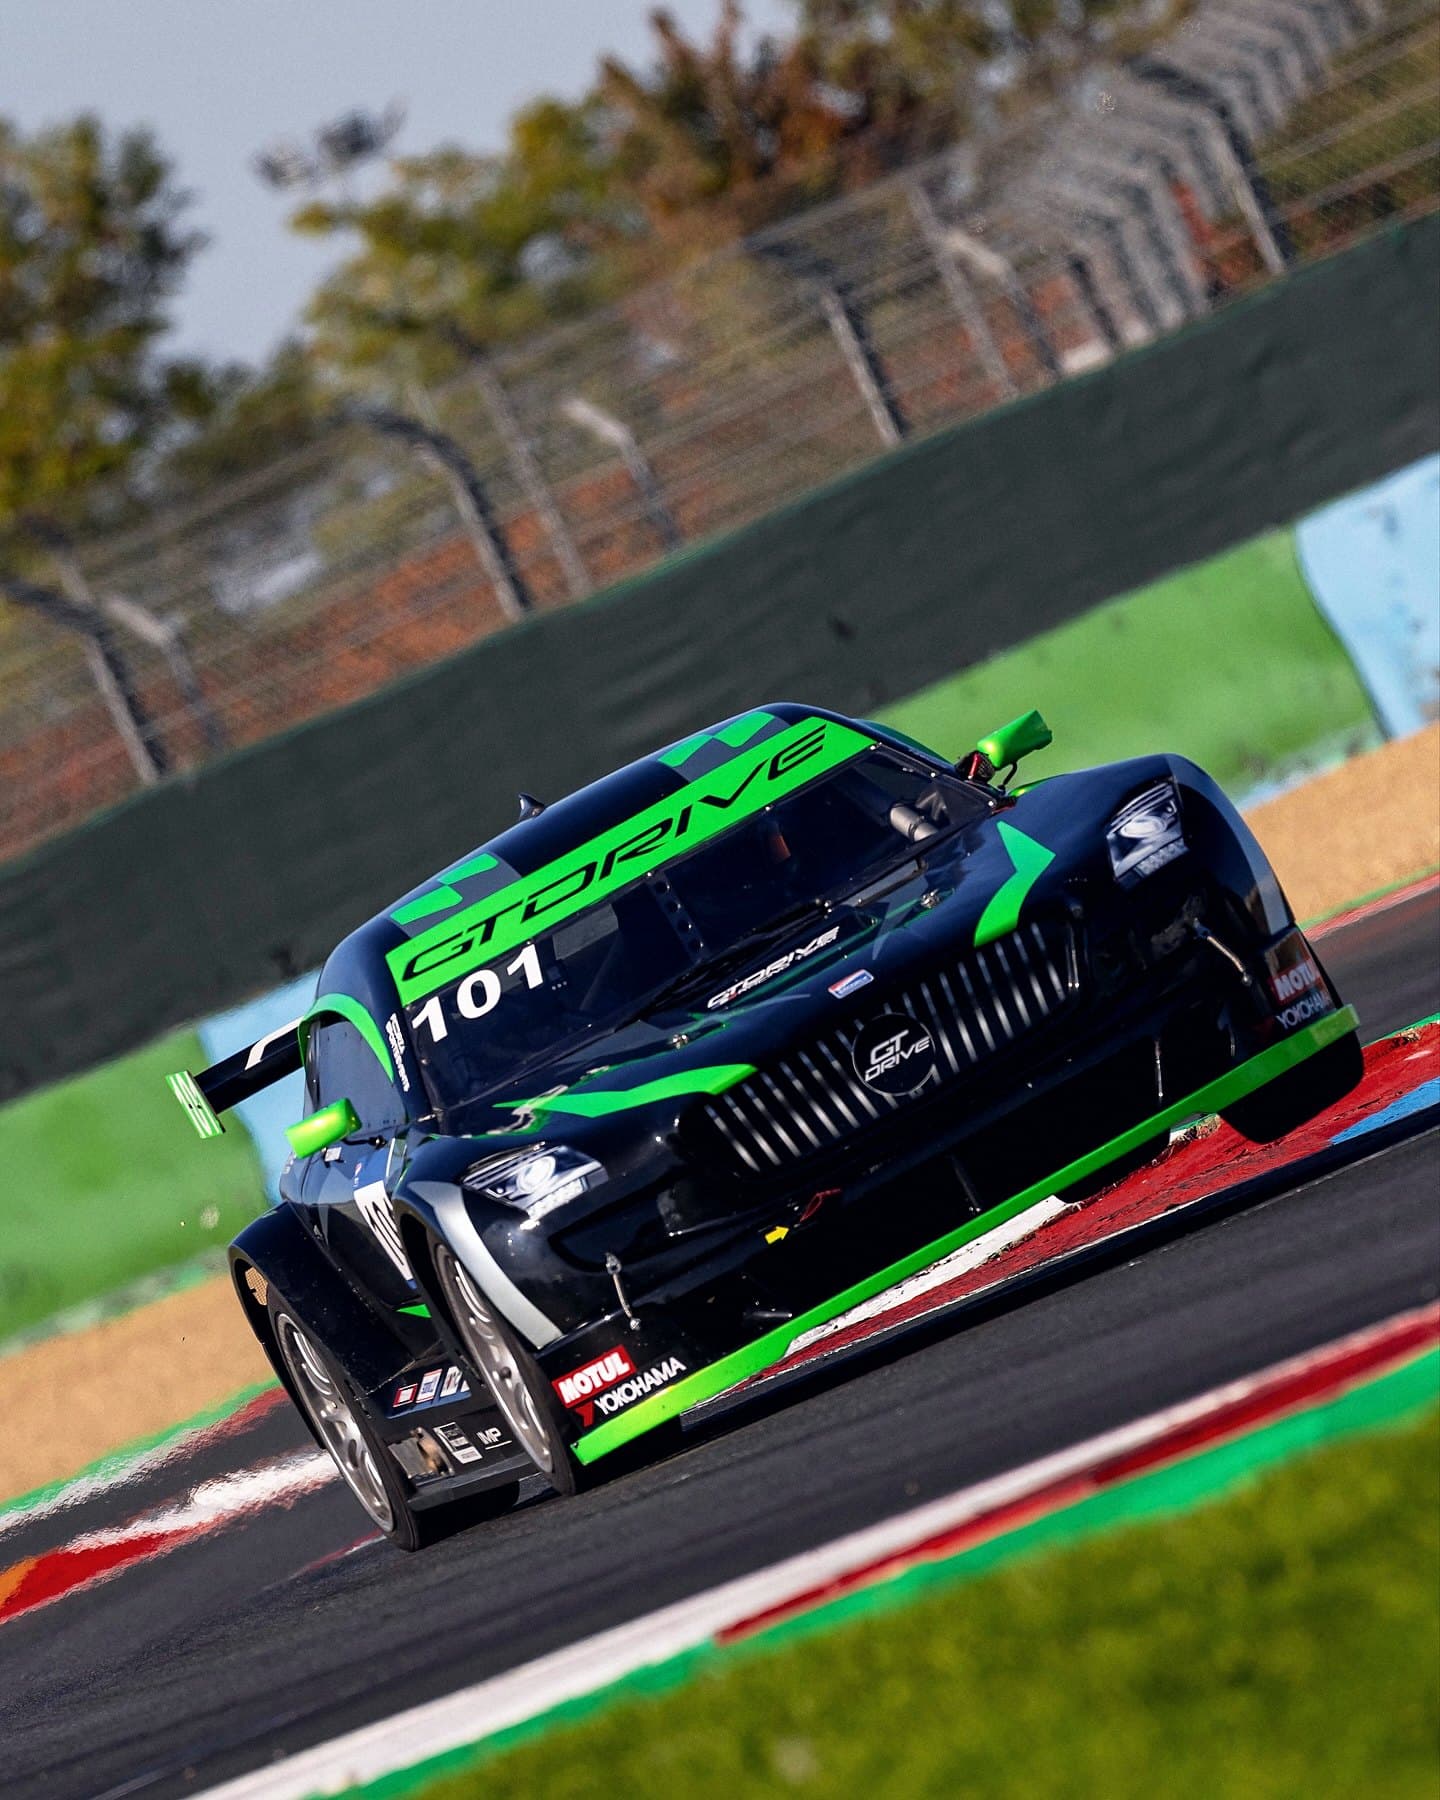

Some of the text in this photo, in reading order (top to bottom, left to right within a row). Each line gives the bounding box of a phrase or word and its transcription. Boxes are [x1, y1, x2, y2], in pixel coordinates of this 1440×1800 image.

[401, 722, 827, 982] GTDRIVE
[411, 944, 544, 1043] 101
[865, 1035, 931, 1083] DRIVE
[870, 1029, 909, 1065] GT
[558, 1351, 630, 1404] MOTUL
[594, 1356, 687, 1415] YOKOHAMA
